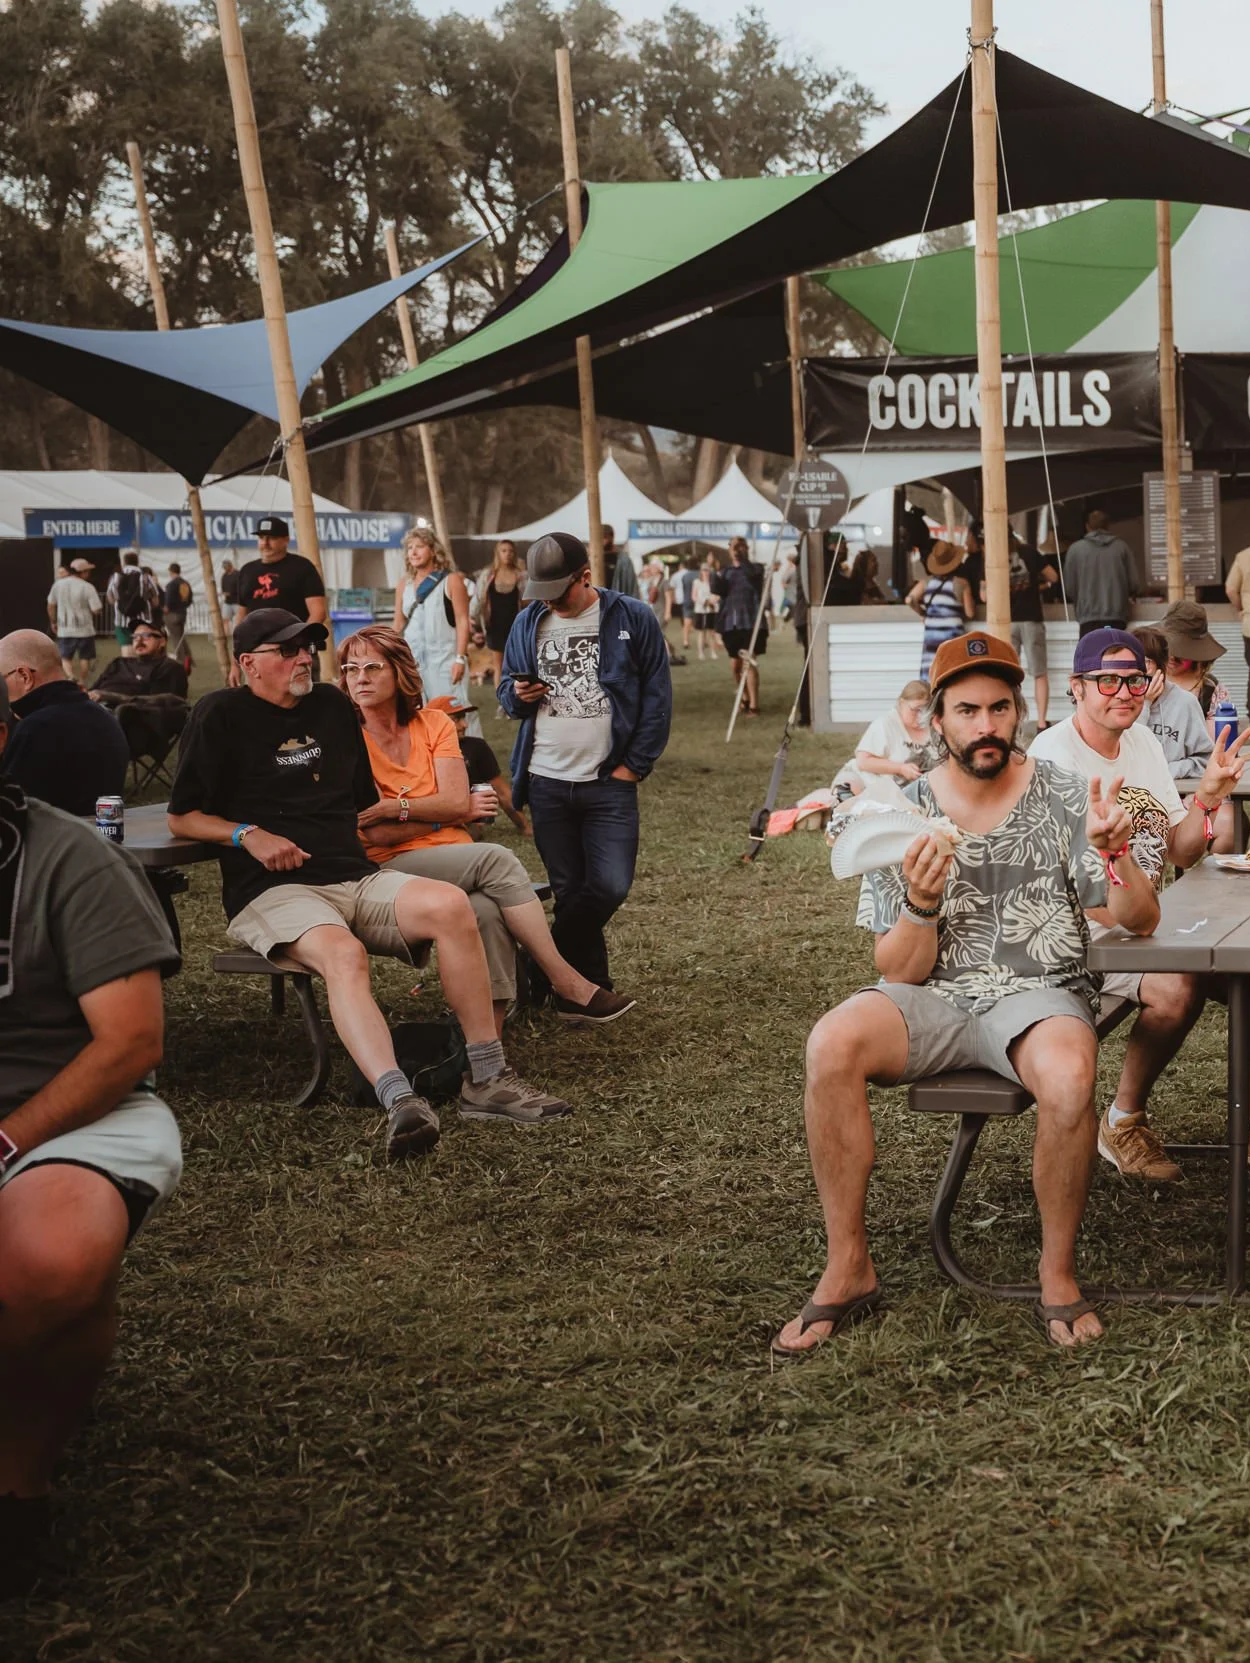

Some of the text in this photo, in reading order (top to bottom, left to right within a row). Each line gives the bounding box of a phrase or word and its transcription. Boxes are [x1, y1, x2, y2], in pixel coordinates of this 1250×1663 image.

[799, 483, 816, 492] CUP
[43, 520, 121, 535] ENTER HERE
[276, 747, 322, 765] GUINNESS
